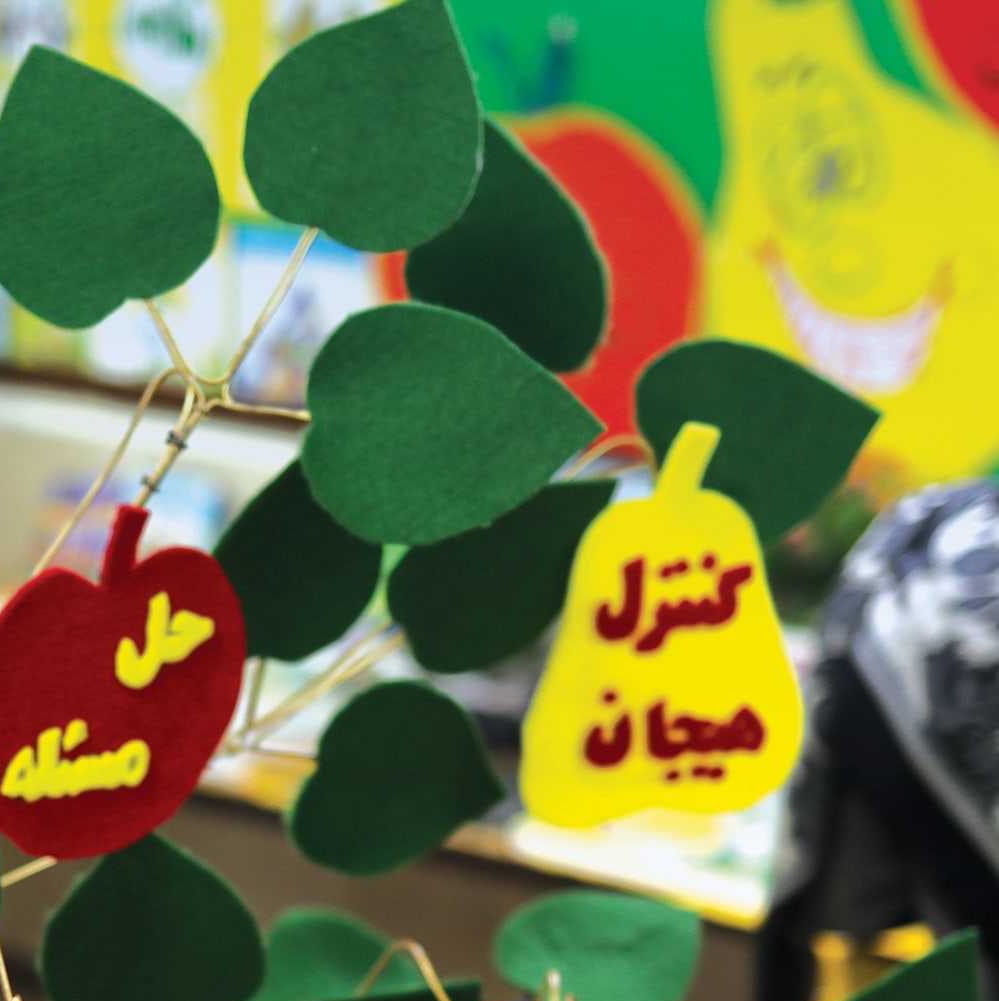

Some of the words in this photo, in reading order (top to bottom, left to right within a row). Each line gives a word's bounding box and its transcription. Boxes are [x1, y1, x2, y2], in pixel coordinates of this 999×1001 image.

[114, 591, 215, 689] حل
[594, 554, 754, 655] کنترل
[0, 719, 151, 802] مسئله
[583, 690, 767, 782] هیجان
